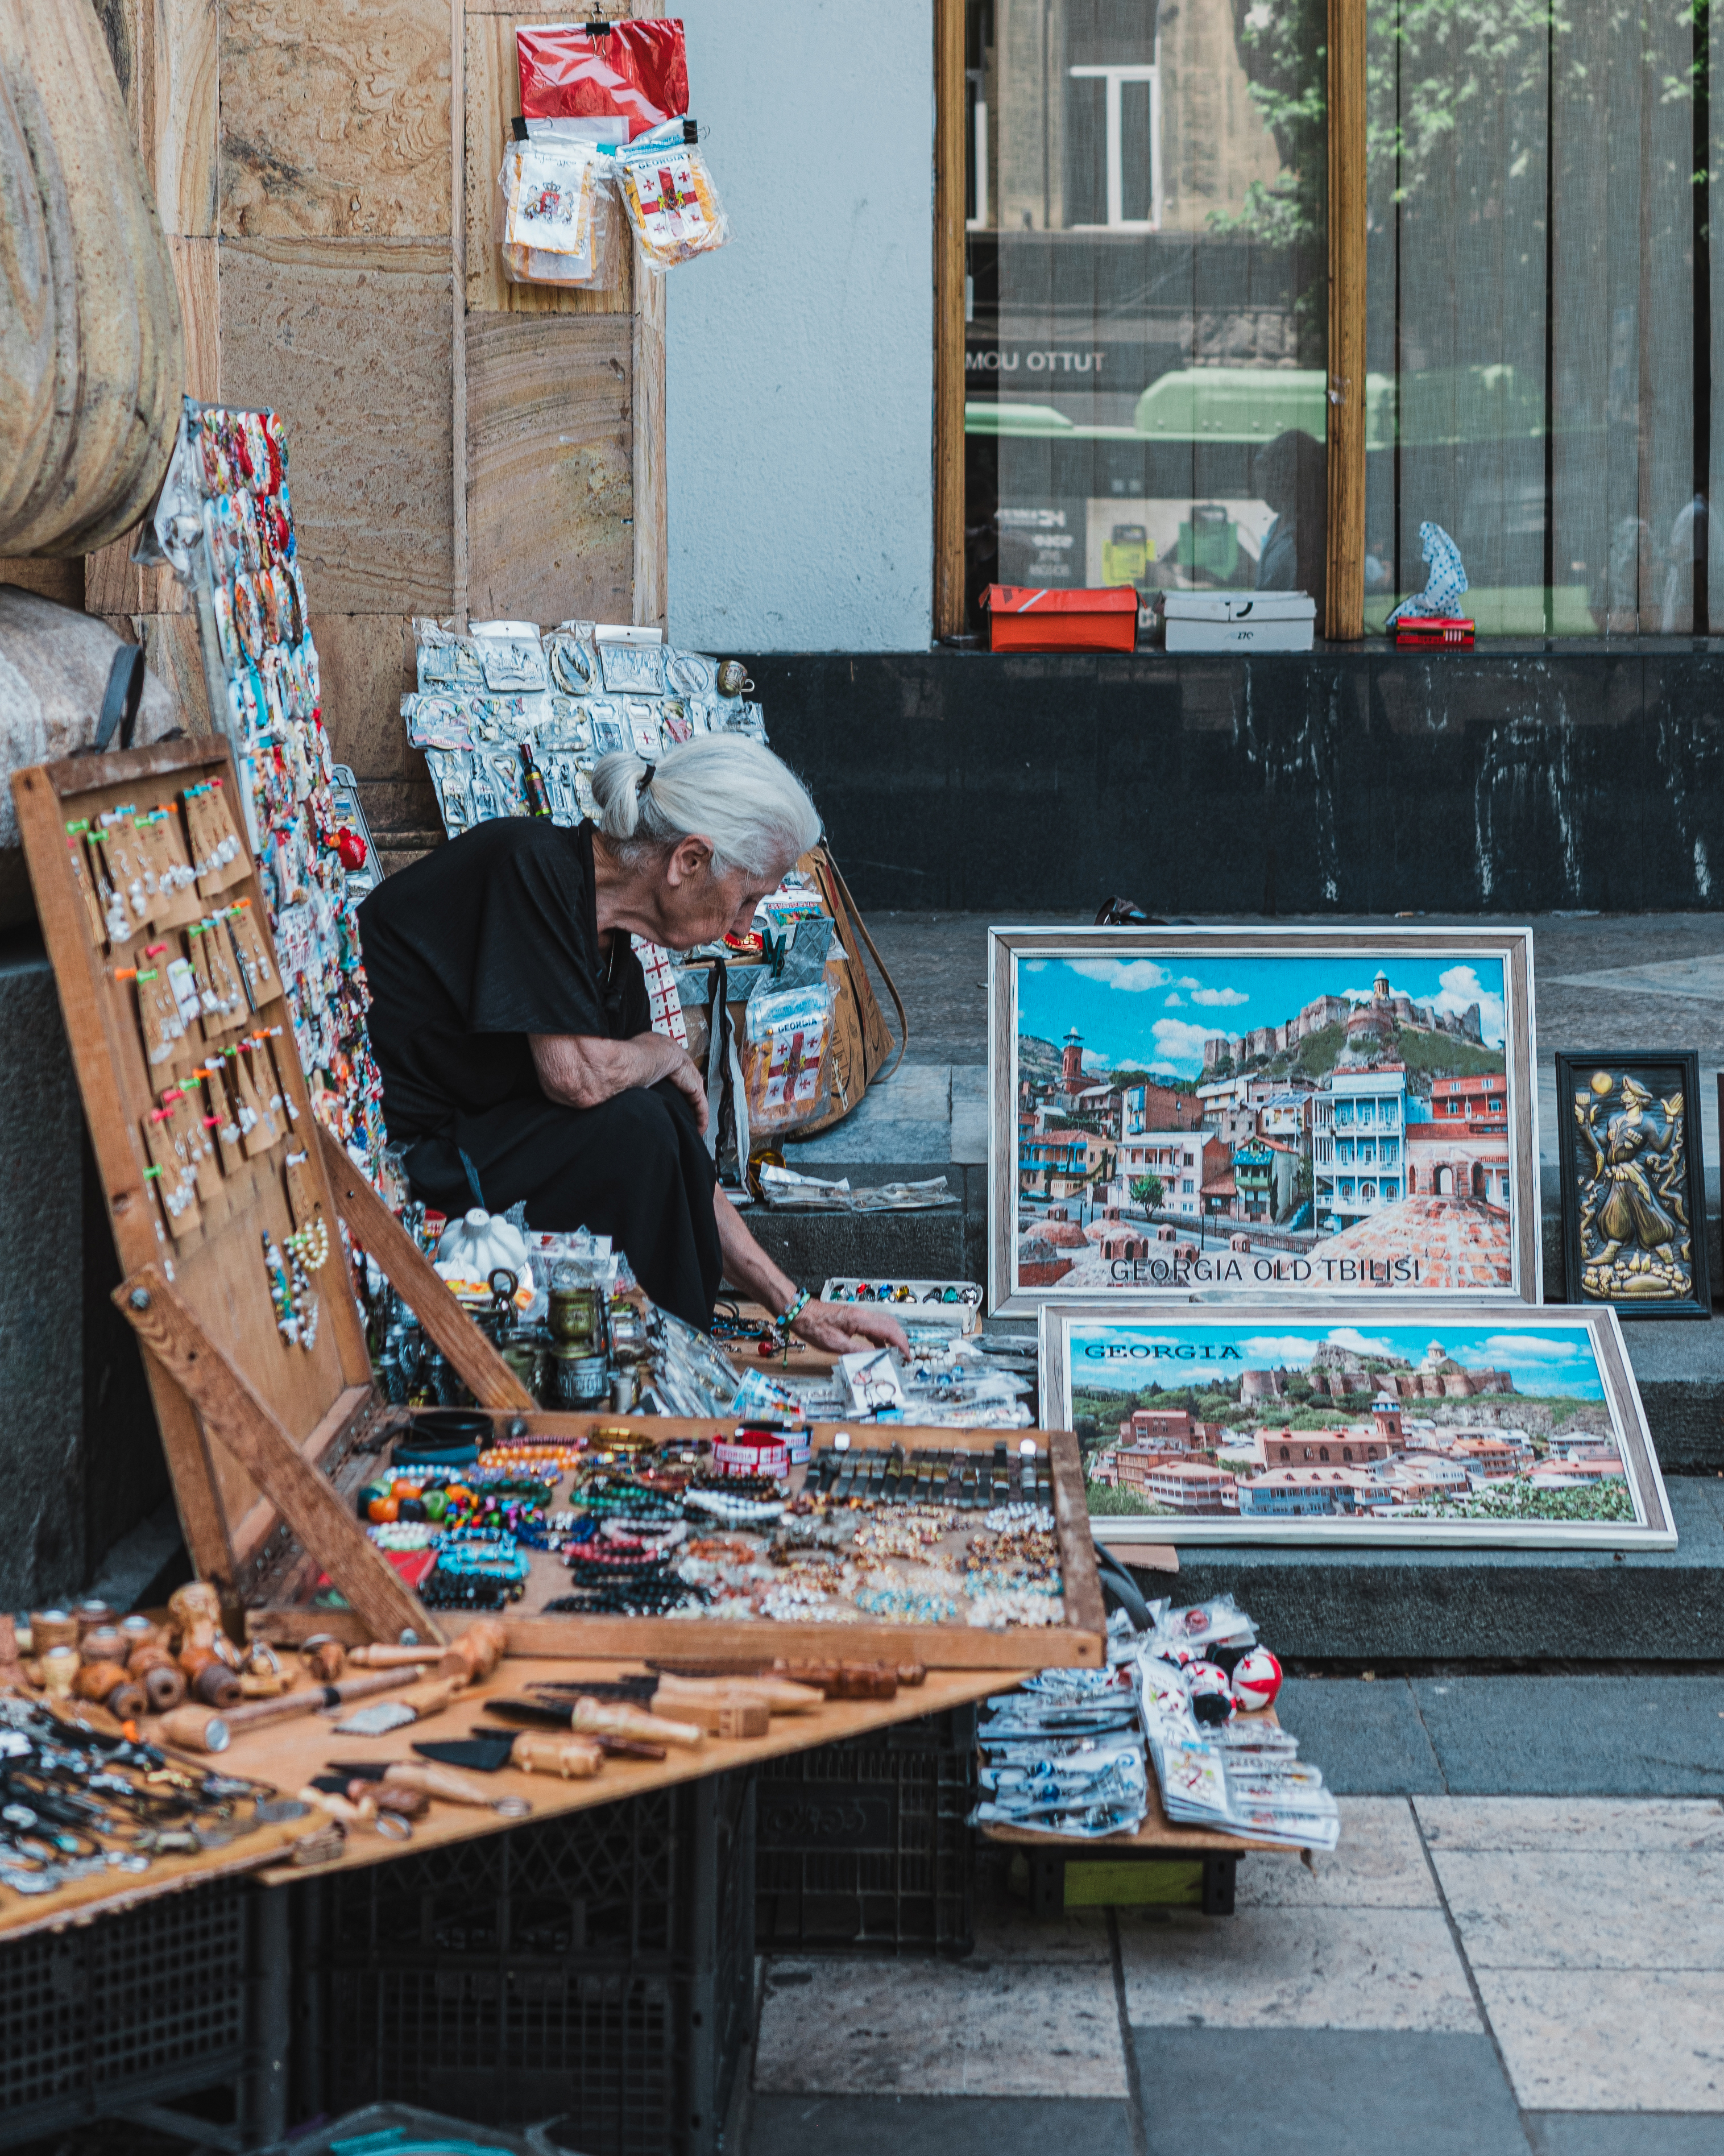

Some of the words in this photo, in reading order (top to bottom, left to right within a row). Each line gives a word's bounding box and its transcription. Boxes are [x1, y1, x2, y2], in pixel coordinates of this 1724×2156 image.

[639, 154, 684, 170] GEORGIA
[778, 1018, 818, 1033] GEORGIA
[1110, 1258, 1244, 1282] GEORGIA
[1253, 1258, 1313, 1282] OLD
[1320, 1258, 1420, 1282] TBILISI
[1084, 1344, 1244, 1360] GEORGIA
